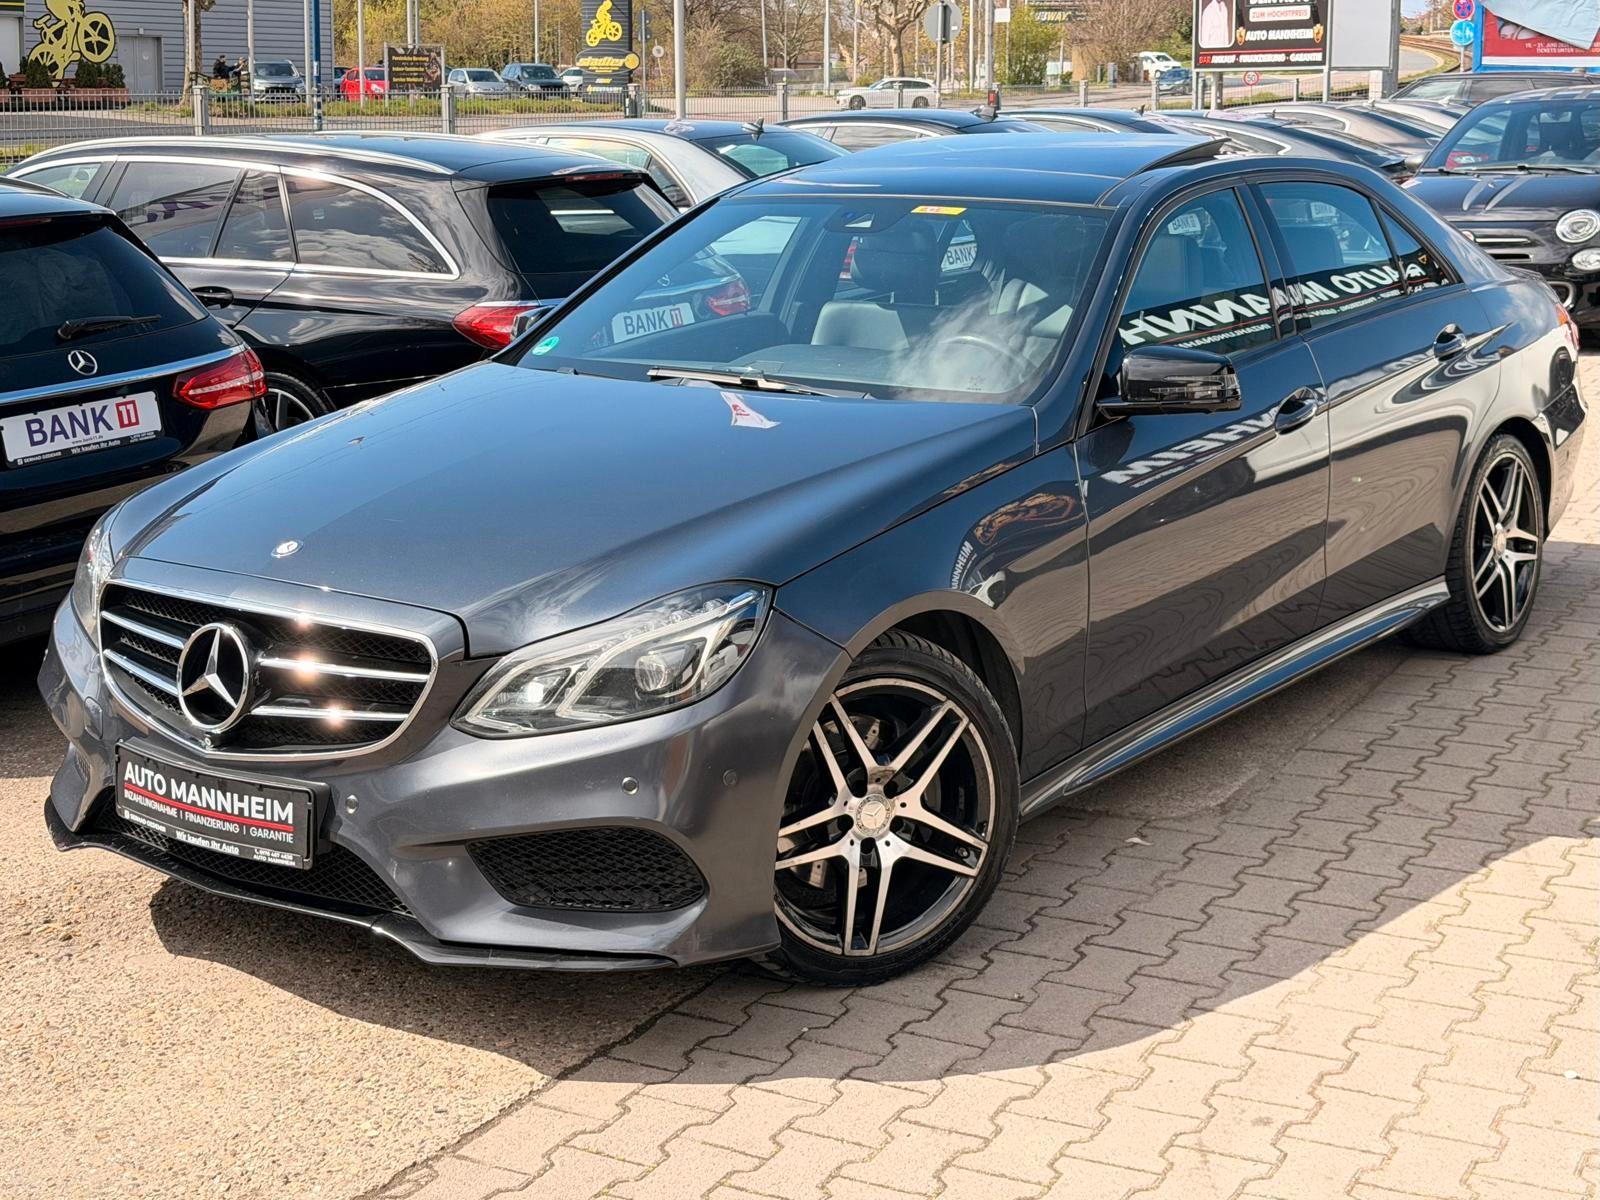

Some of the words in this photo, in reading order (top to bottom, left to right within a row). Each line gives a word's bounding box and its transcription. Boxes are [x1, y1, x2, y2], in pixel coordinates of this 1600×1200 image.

[1245, 30, 1267, 41] AUTO
[1268, 28, 1314, 40] MANNHEIM
[946, 246, 975, 265] BANK
[623, 309, 669, 336] BANK
[25, 404, 114, 447] BANK
[118, 402, 138, 426] 11
[124, 761, 167, 796] AUTO
[170, 778, 294, 825] MANNHEIM
[185, 812, 240, 835] FINANZIERUNG
[249, 826, 294, 844] GARANTIE
[175, 830, 187, 841] Wir
[187, 832, 210, 848] kaufen
[221, 842, 240, 855] Auto
